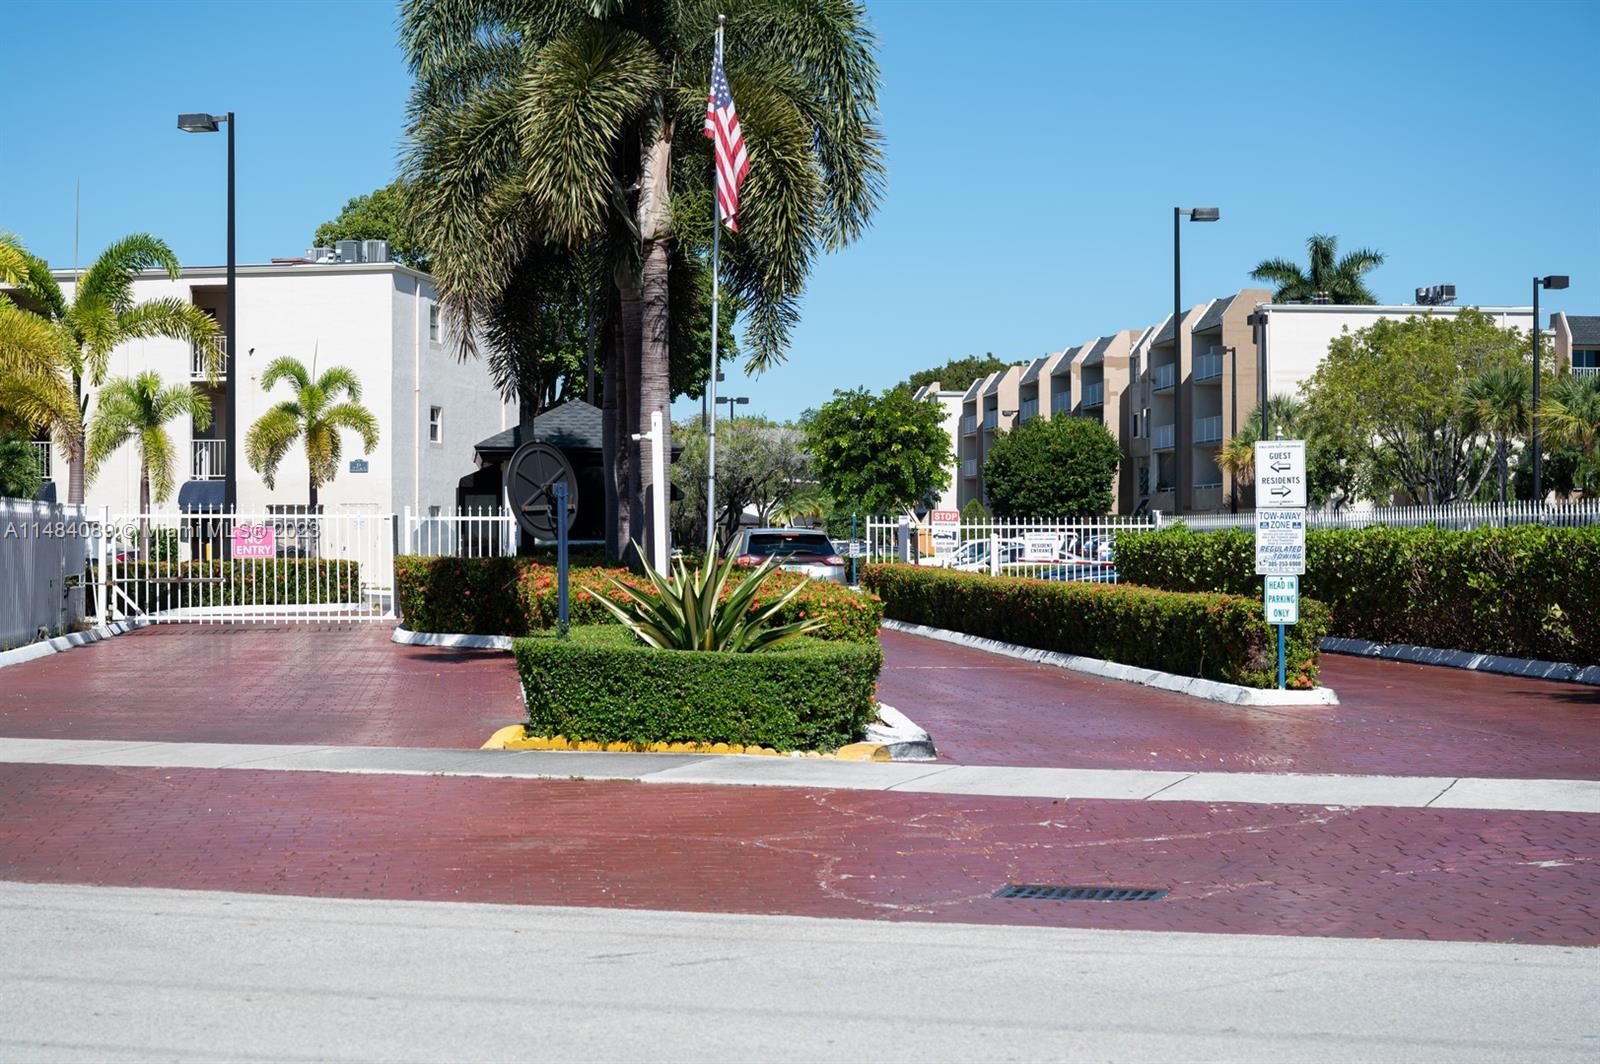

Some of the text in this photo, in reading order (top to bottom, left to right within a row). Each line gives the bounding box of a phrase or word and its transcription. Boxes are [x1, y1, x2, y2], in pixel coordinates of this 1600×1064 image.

[1269, 452, 1291, 460] GUEST
[1261, 476, 1301, 485] RESIDENTS
[934, 511, 958, 520] STOP
[1259, 511, 1302, 520] TOW-AWAY
[1270, 520, 1291, 529] ZONE
[236, 545, 271, 555] ENTRY
[1260, 545, 1303, 553] REGULATED
[1269, 581, 1295, 589] HEAD IN
[1268, 595, 1295, 603] PARKING
[1273, 609, 1290, 617] ONLY
